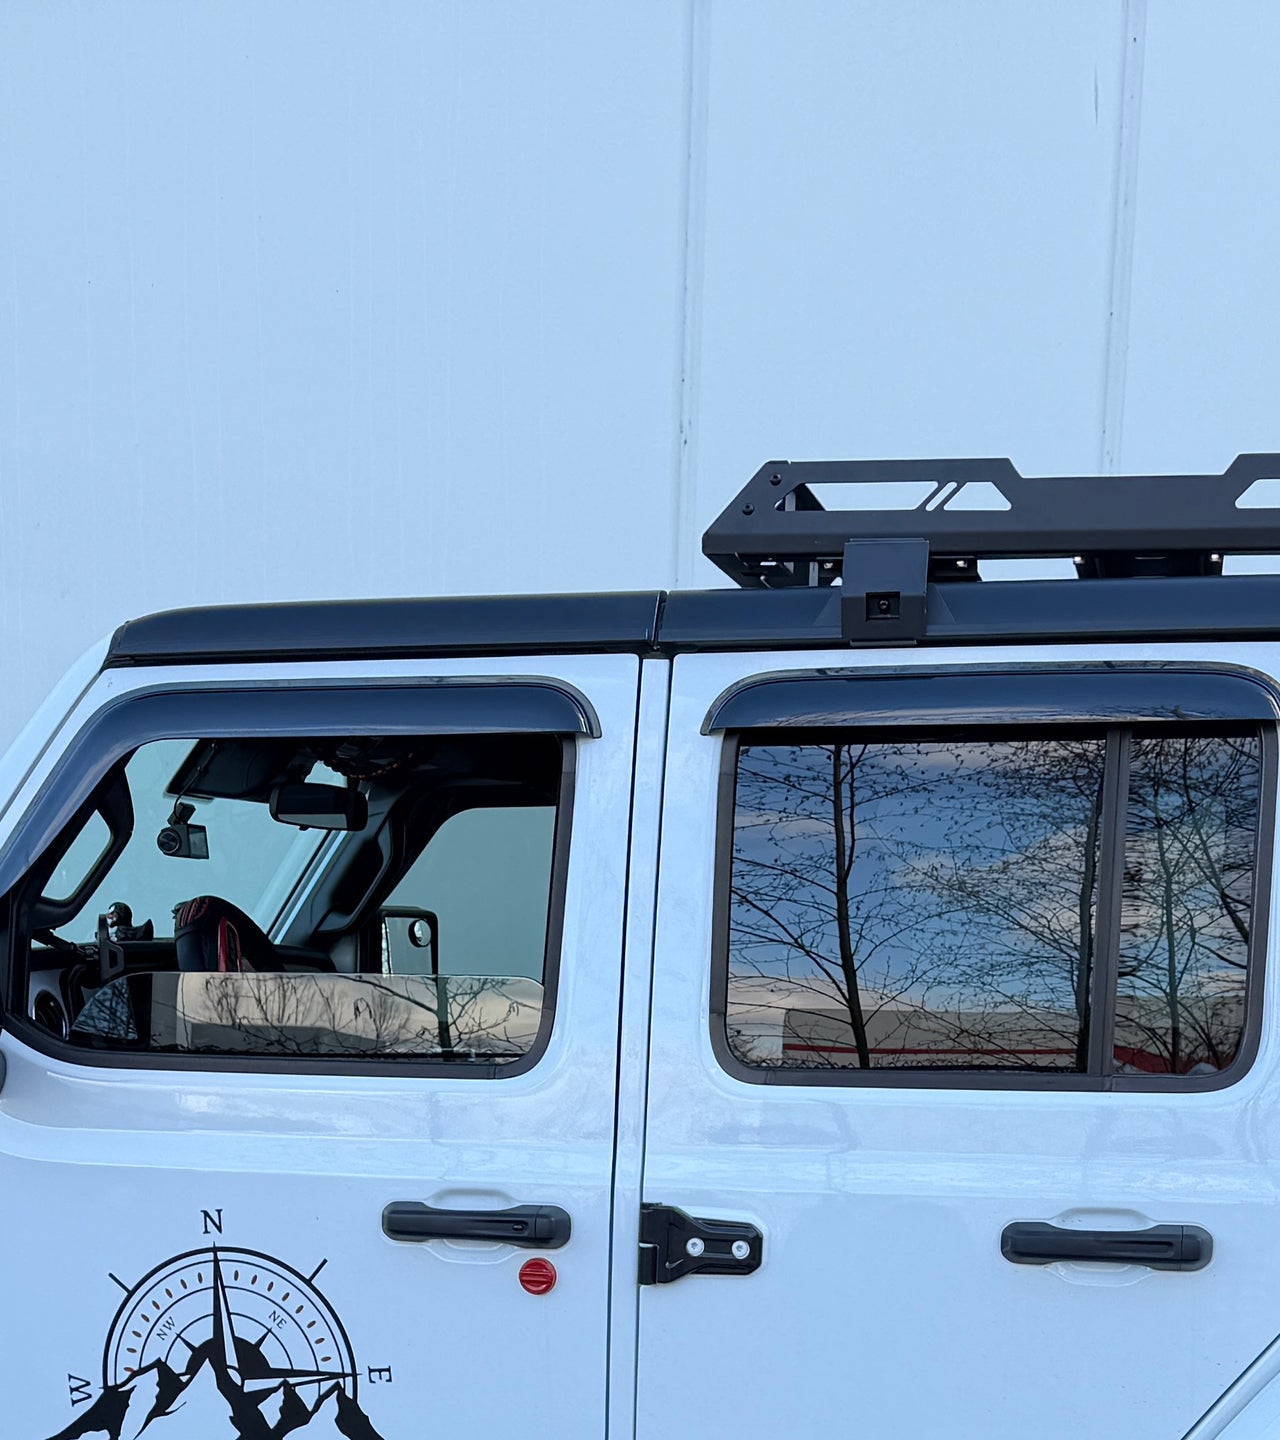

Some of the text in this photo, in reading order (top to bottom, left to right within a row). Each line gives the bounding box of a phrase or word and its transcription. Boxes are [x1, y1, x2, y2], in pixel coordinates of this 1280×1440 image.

[200, 1208, 223, 1235] N
[156, 1316, 176, 1342] NW
[268, 1309, 288, 1330] NE
[367, 1365, 393, 1386] E
[67, 1373, 93, 1408] W
